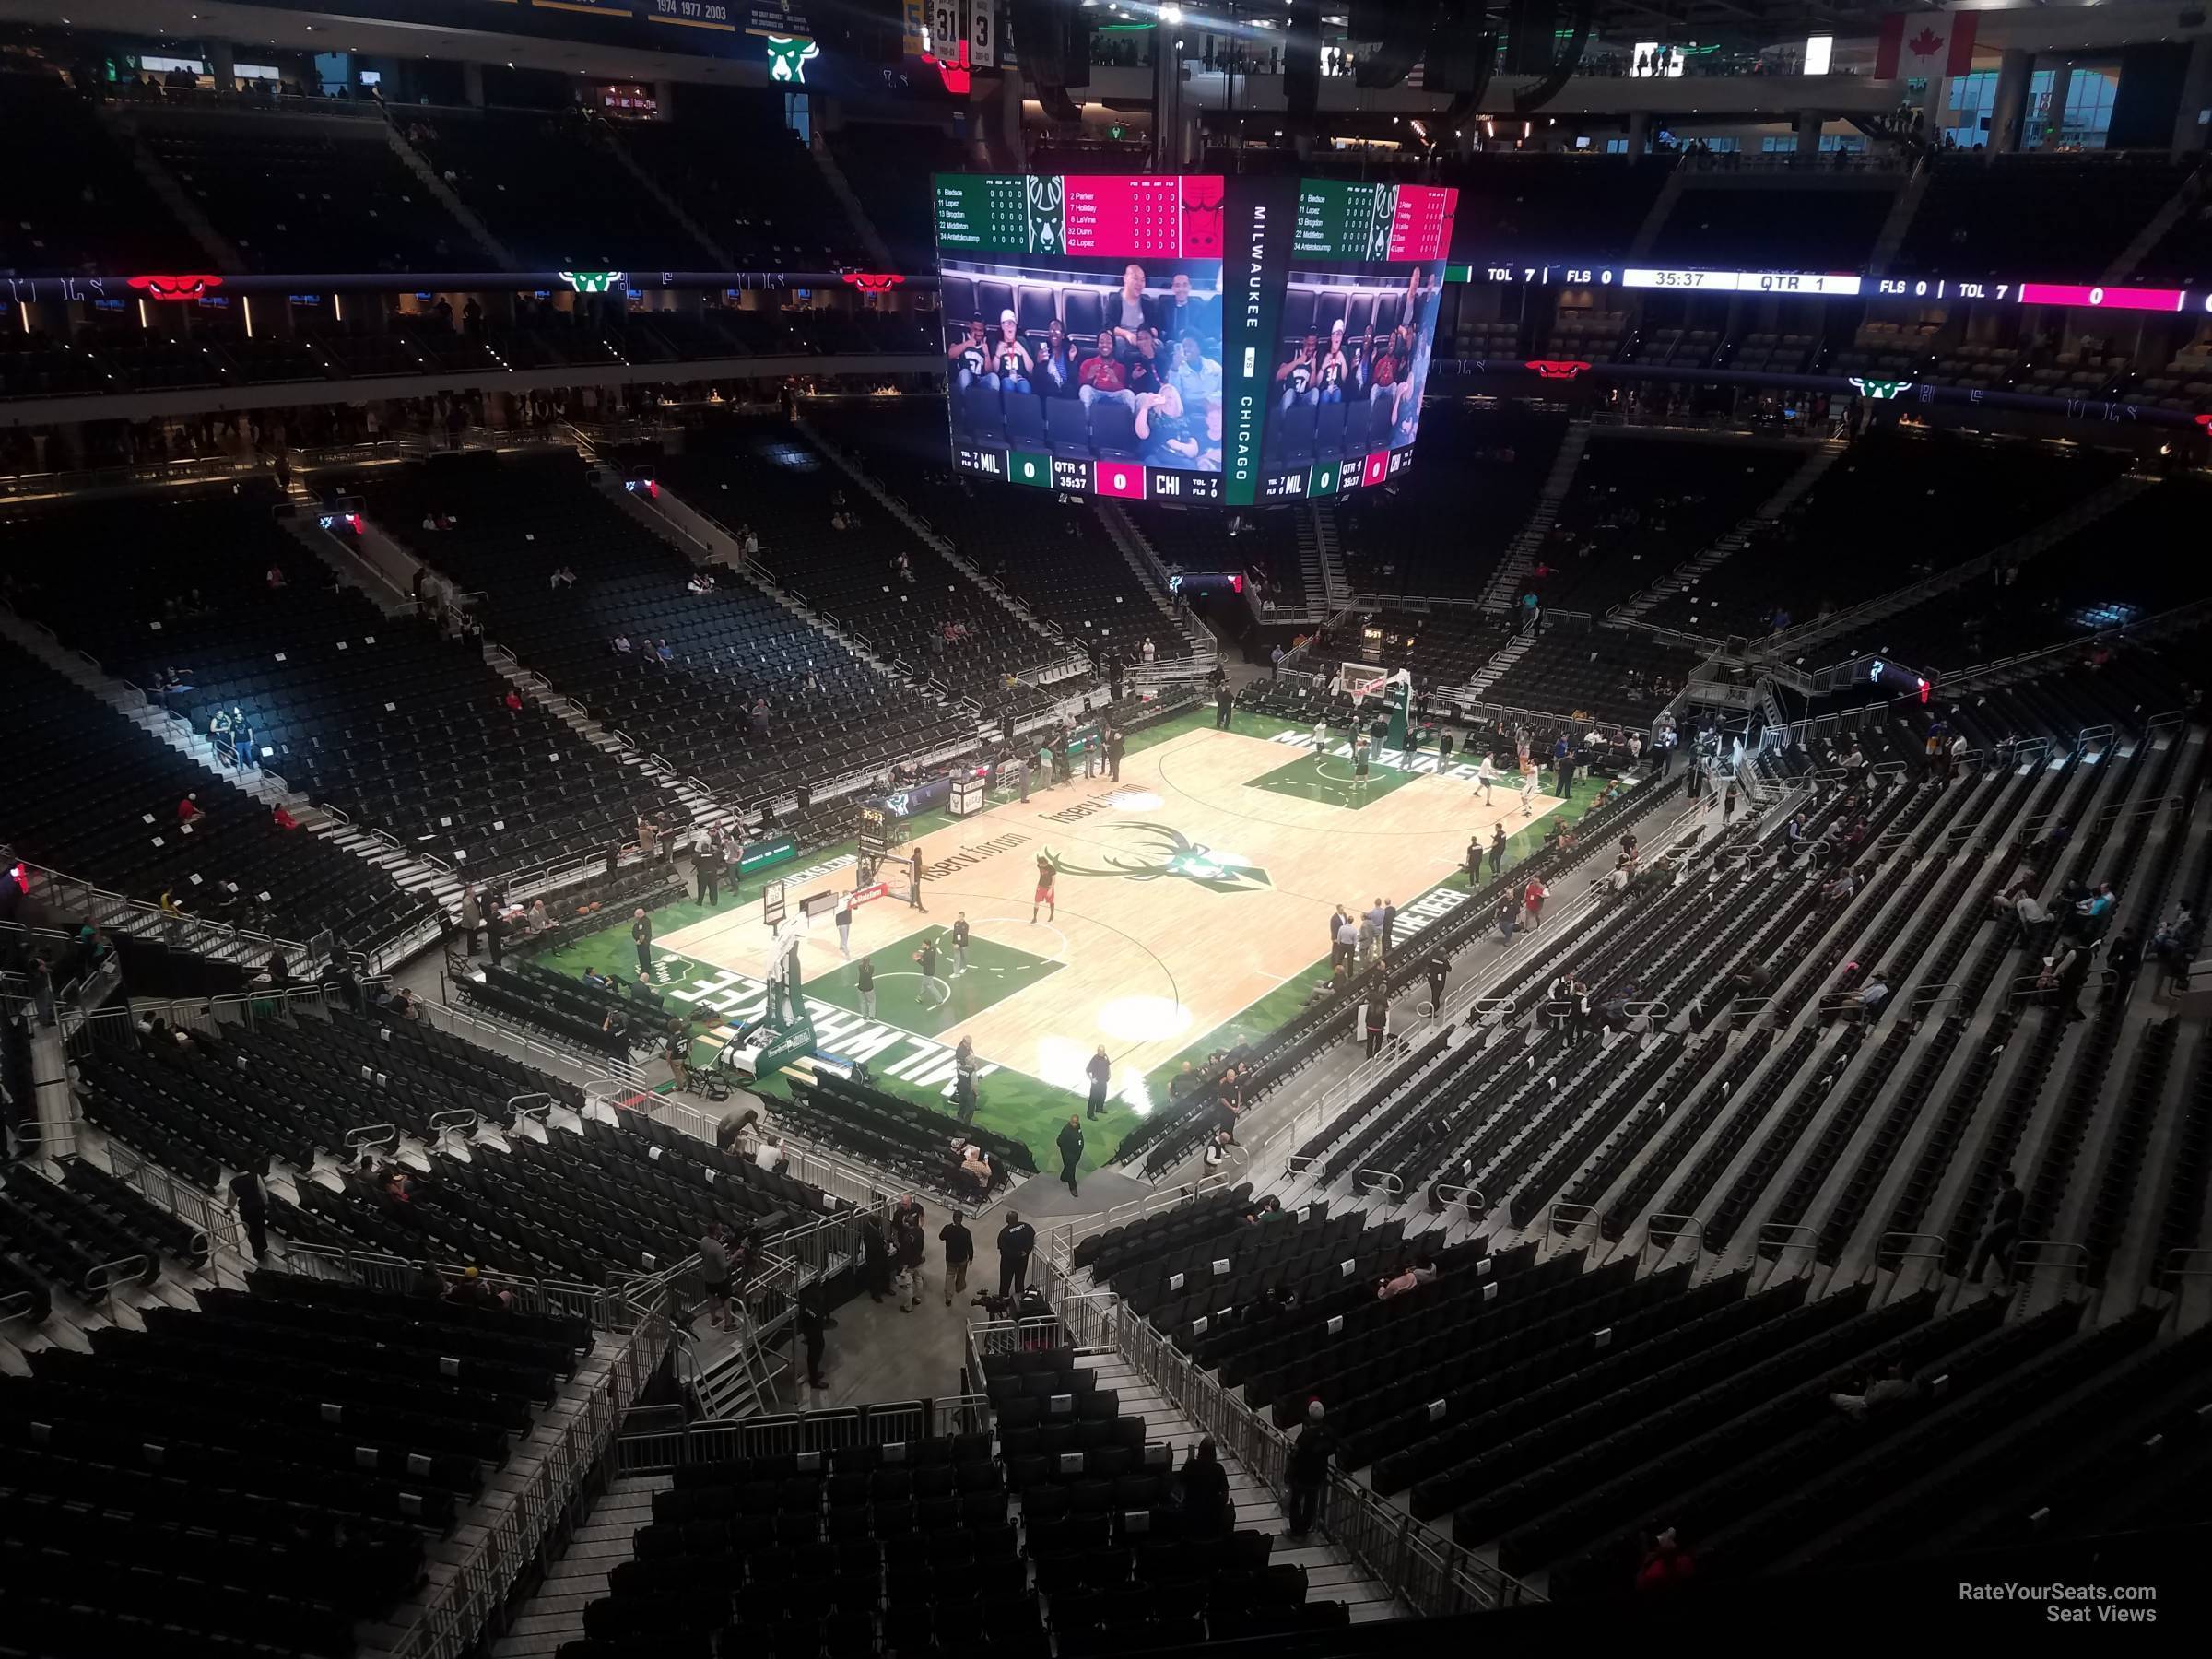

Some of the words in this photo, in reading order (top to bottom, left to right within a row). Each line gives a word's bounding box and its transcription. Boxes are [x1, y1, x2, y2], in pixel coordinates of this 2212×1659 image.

[657, 0, 677, 13] 1974
[681, 1, 700, 17] 1977
[705, 5, 726, 20] 2003
[937, 8, 957, 42] 31
[976, 16, 988, 47] 3
[946, 210, 965, 219] Brogdon
[1076, 204, 1098, 213] Holiday
[1134, 205, 1139, 213] 0
[1146, 205, 1151, 213] 0
[1158, 205, 1163, 213] 0
[1170, 205, 1175, 213] 0
[1134, 217, 1139, 225] 0
[1146, 217, 1151, 225] 0
[1158, 217, 1163, 225] 0
[1170, 217, 1175, 225] 0
[1077, 240, 1095, 248] Lopez
[1247, 206, 1266, 327] MILWAUKEE
[1488, 268, 1512, 281] TOL
[1524, 269, 1535, 281] 7
[1567, 270, 1591, 283] FLS
[1601, 270, 1612, 284] 0
[1656, 272, 1704, 287] 35:37
[1760, 276, 1800, 292] QTR
[1816, 278, 1824, 290] 1
[1879, 280, 1906, 294] FLS
[1916, 281, 1927, 296] 0
[1959, 283, 1985, 298] TOL
[1996, 285, 2008, 300] 7
[2089, 288, 2103, 305] 0
[1236, 396, 1252, 480] CHICAGO
[973, 452, 978, 460] 7
[981, 453, 1000, 474] MIL
[1390, 453, 1401, 473] CHI
[974, 461, 979, 469] 0
[1024, 462, 1035, 478] 0
[1054, 461, 1076, 474] QTR
[1079, 464, 1087, 475] 1
[1342, 464, 1356, 476] QTR
[1357, 461, 1362, 471] 1
[1372, 462, 1381, 478] 0
[1060, 477, 1087, 488] 35:37
[1113, 473, 1126, 490] 0
[1156, 475, 1180, 495] CHI
[1210, 478, 1218, 488] 7
[1280, 477, 1286, 485] 7
[1285, 475, 1301, 495] MIL
[1320, 472, 1329, 488] 0
[1343, 476, 1360, 488] 35:37
[1210, 488, 1218, 498] 0
[1408, 888, 1471, 917] DEER
